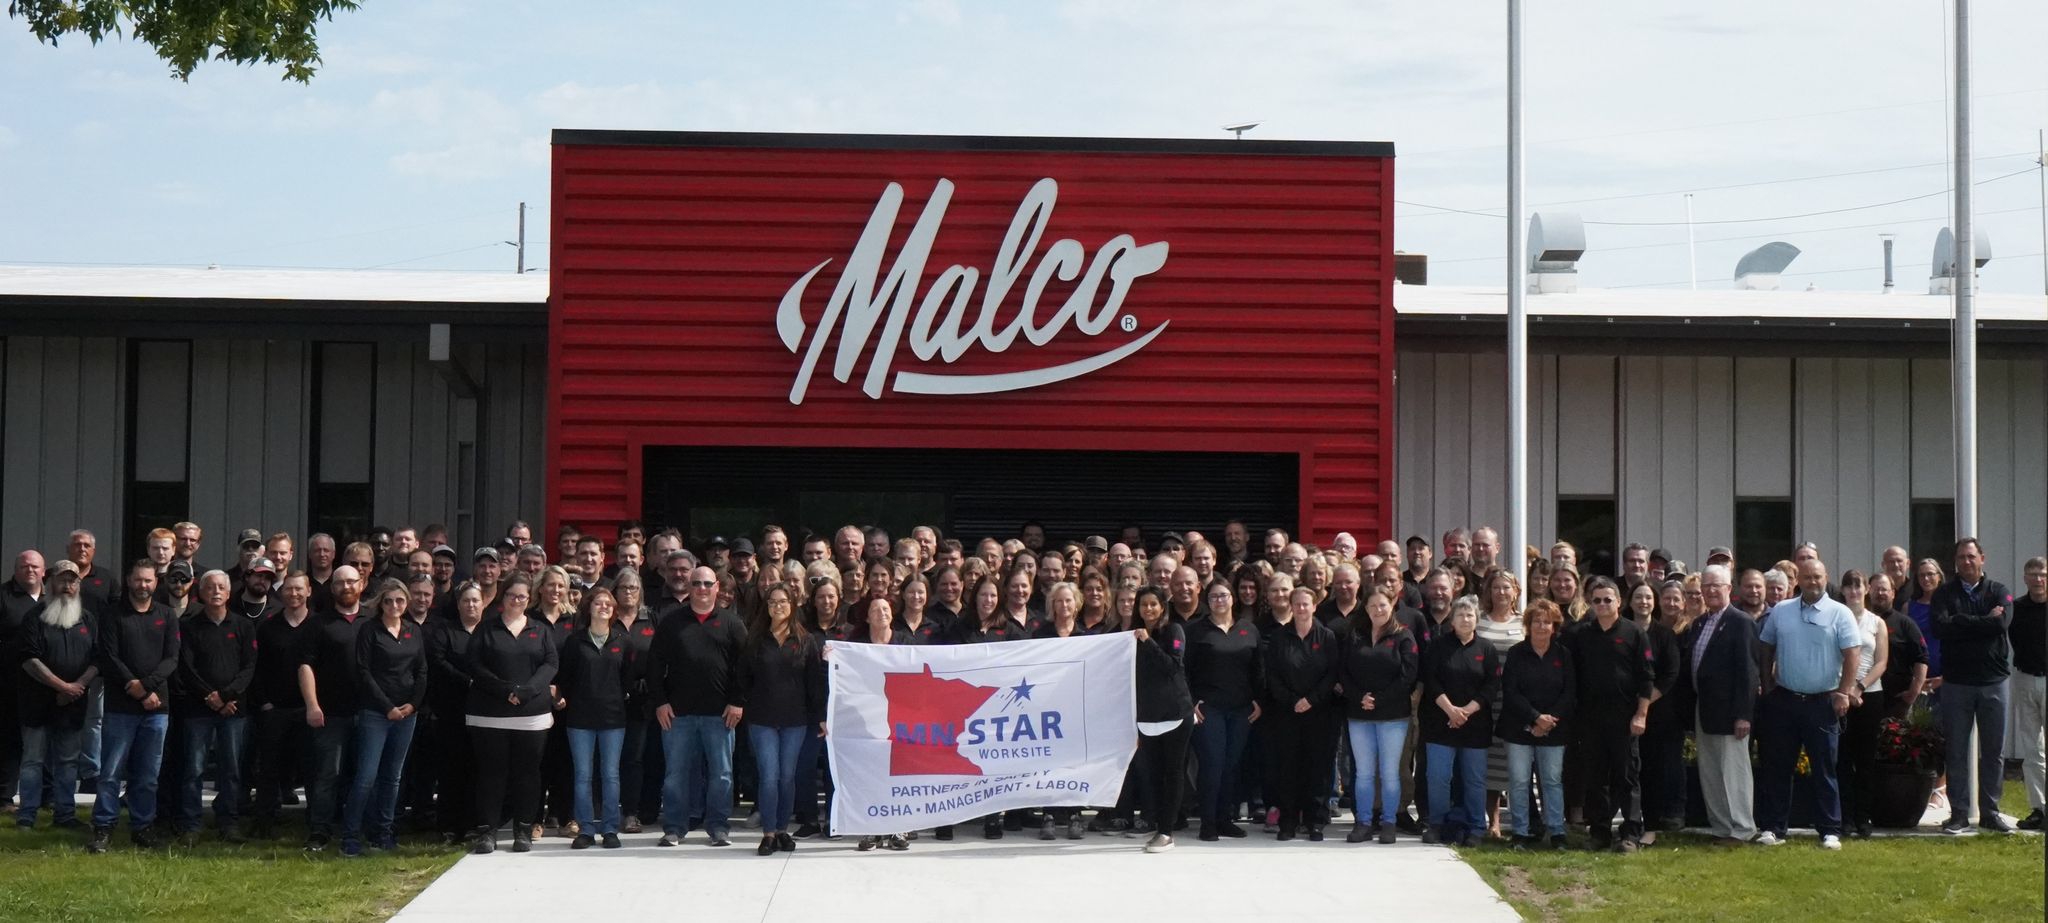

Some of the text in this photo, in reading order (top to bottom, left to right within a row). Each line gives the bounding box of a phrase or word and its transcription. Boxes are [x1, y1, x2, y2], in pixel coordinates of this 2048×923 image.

[776, 177, 1170, 405] Malco
[895, 711, 1064, 746] MN STAR
[978, 746, 1052, 760] WORKSITE
[867, 780, 1090, 817] OSHA MANAGEMENT LABOR
[891, 782, 969, 798] PARTNERS
